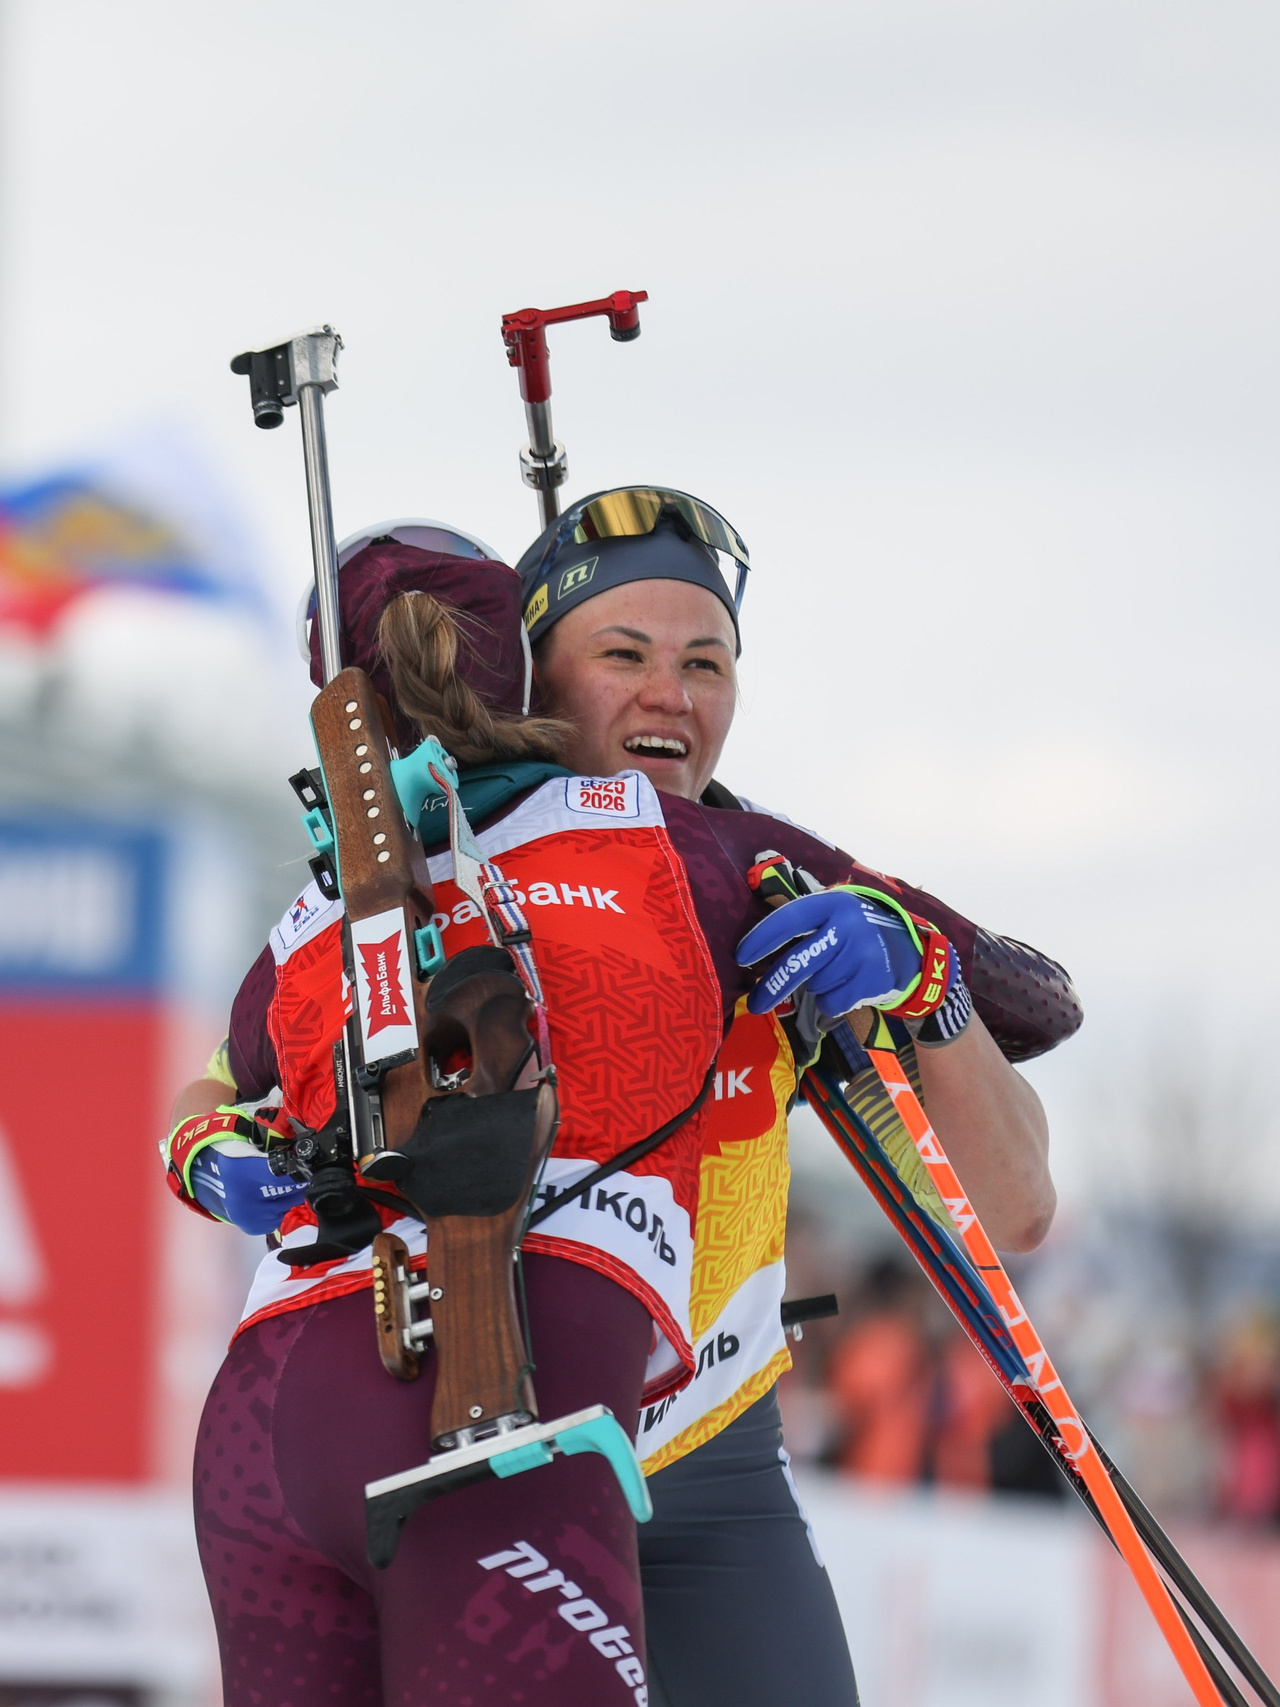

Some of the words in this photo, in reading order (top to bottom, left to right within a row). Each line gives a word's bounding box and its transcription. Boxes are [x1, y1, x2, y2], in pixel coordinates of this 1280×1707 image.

[580, 791, 626, 811] 2026
[376, 951, 390, 981] Банк
[904, 947, 946, 1017] LEKI
[378, 981, 392, 1016] Альфа
[176, 1115, 232, 1151] LEKI
